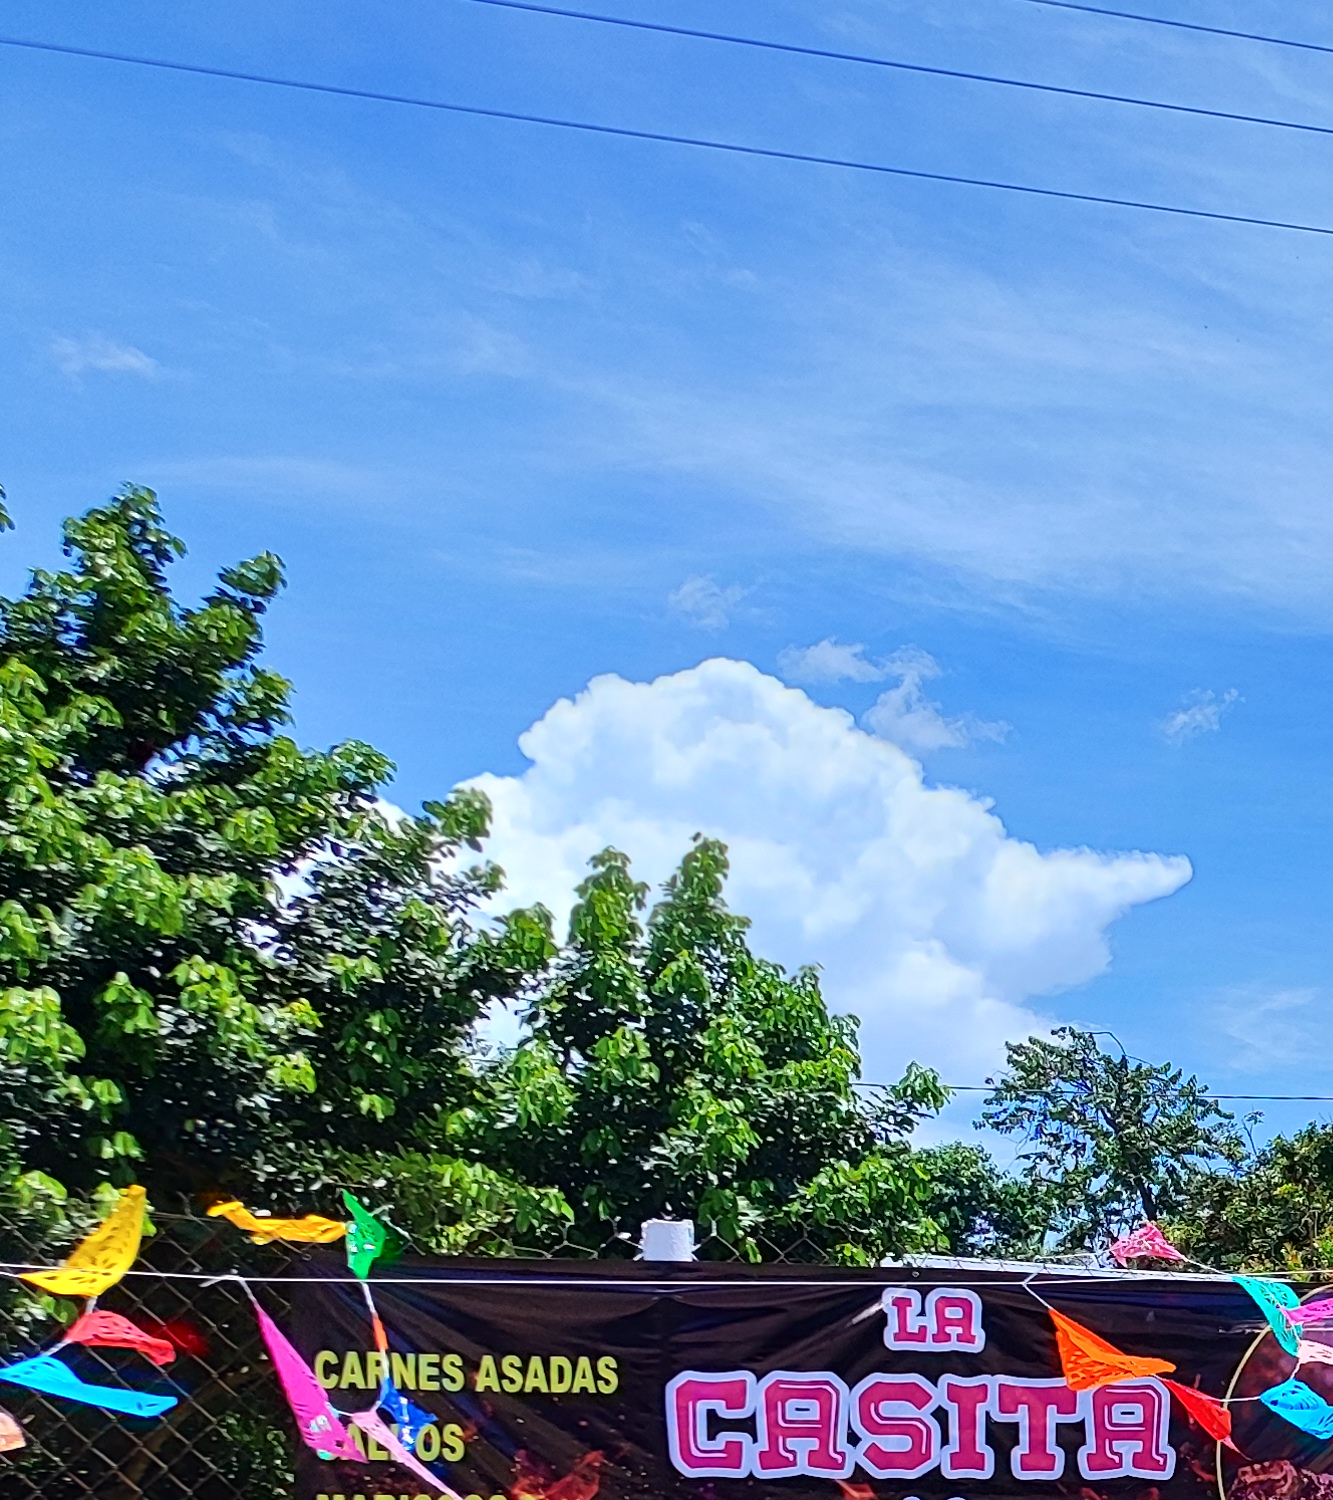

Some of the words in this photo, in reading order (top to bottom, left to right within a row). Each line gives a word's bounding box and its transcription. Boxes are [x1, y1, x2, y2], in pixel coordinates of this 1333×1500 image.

[886, 1290, 983, 1350] LA
[314, 1350, 465, 1392] CARNES
[475, 1355, 619, 1394] ASADAS
[667, 1372, 1175, 1479] CASITA
